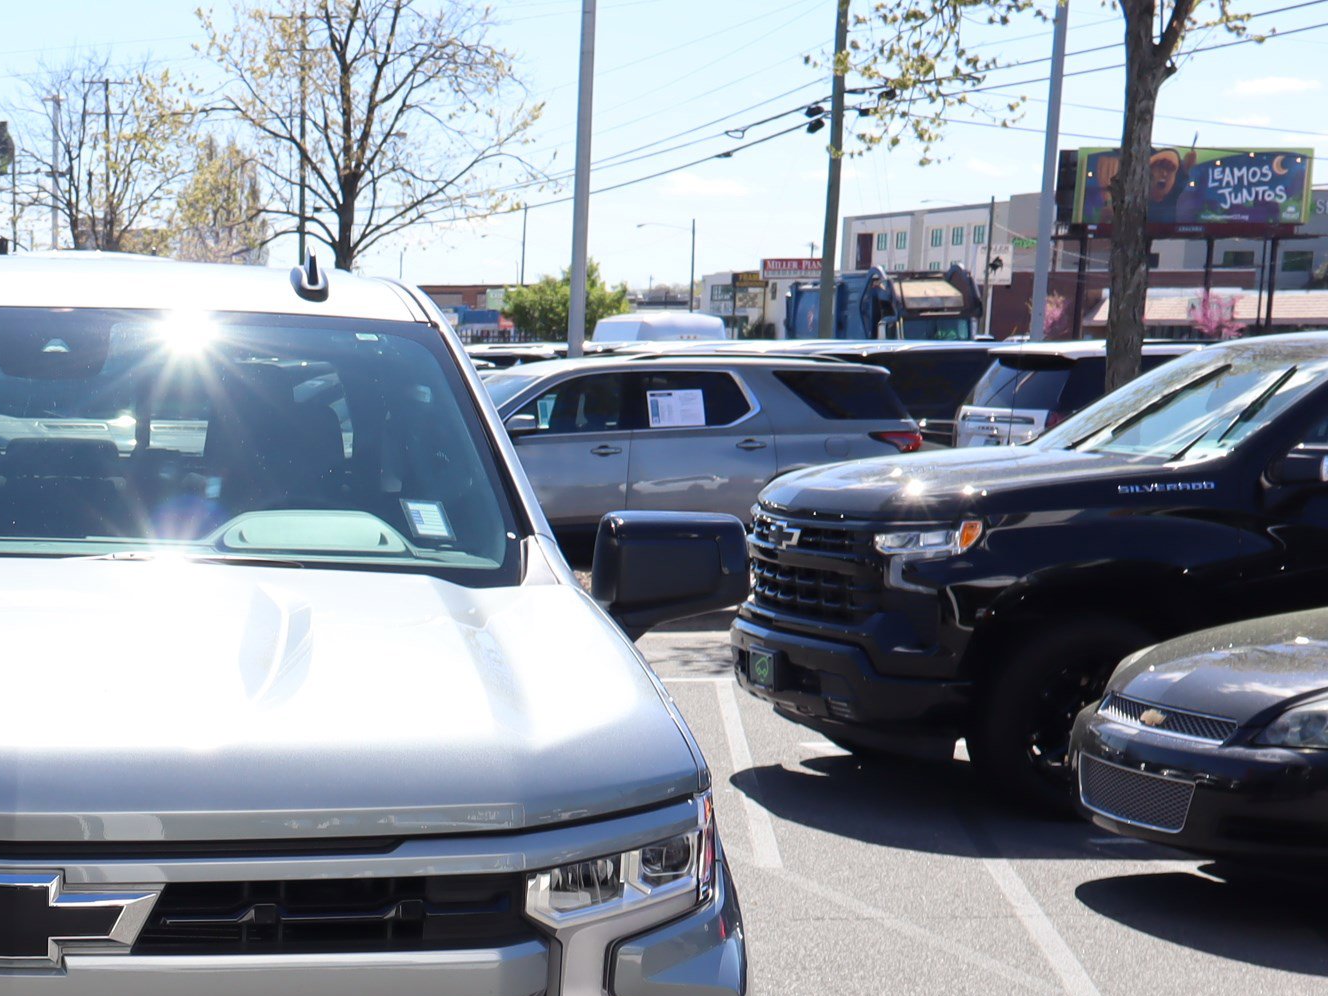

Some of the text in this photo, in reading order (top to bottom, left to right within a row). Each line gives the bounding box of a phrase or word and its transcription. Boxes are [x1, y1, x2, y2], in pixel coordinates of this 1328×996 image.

[1208, 165, 1272, 188] LEAMOS
[1217, 185, 1287, 209] JUNTOS
[766, 260, 799, 269] MILLER
[1118, 481, 1215, 493] SILVERADO
